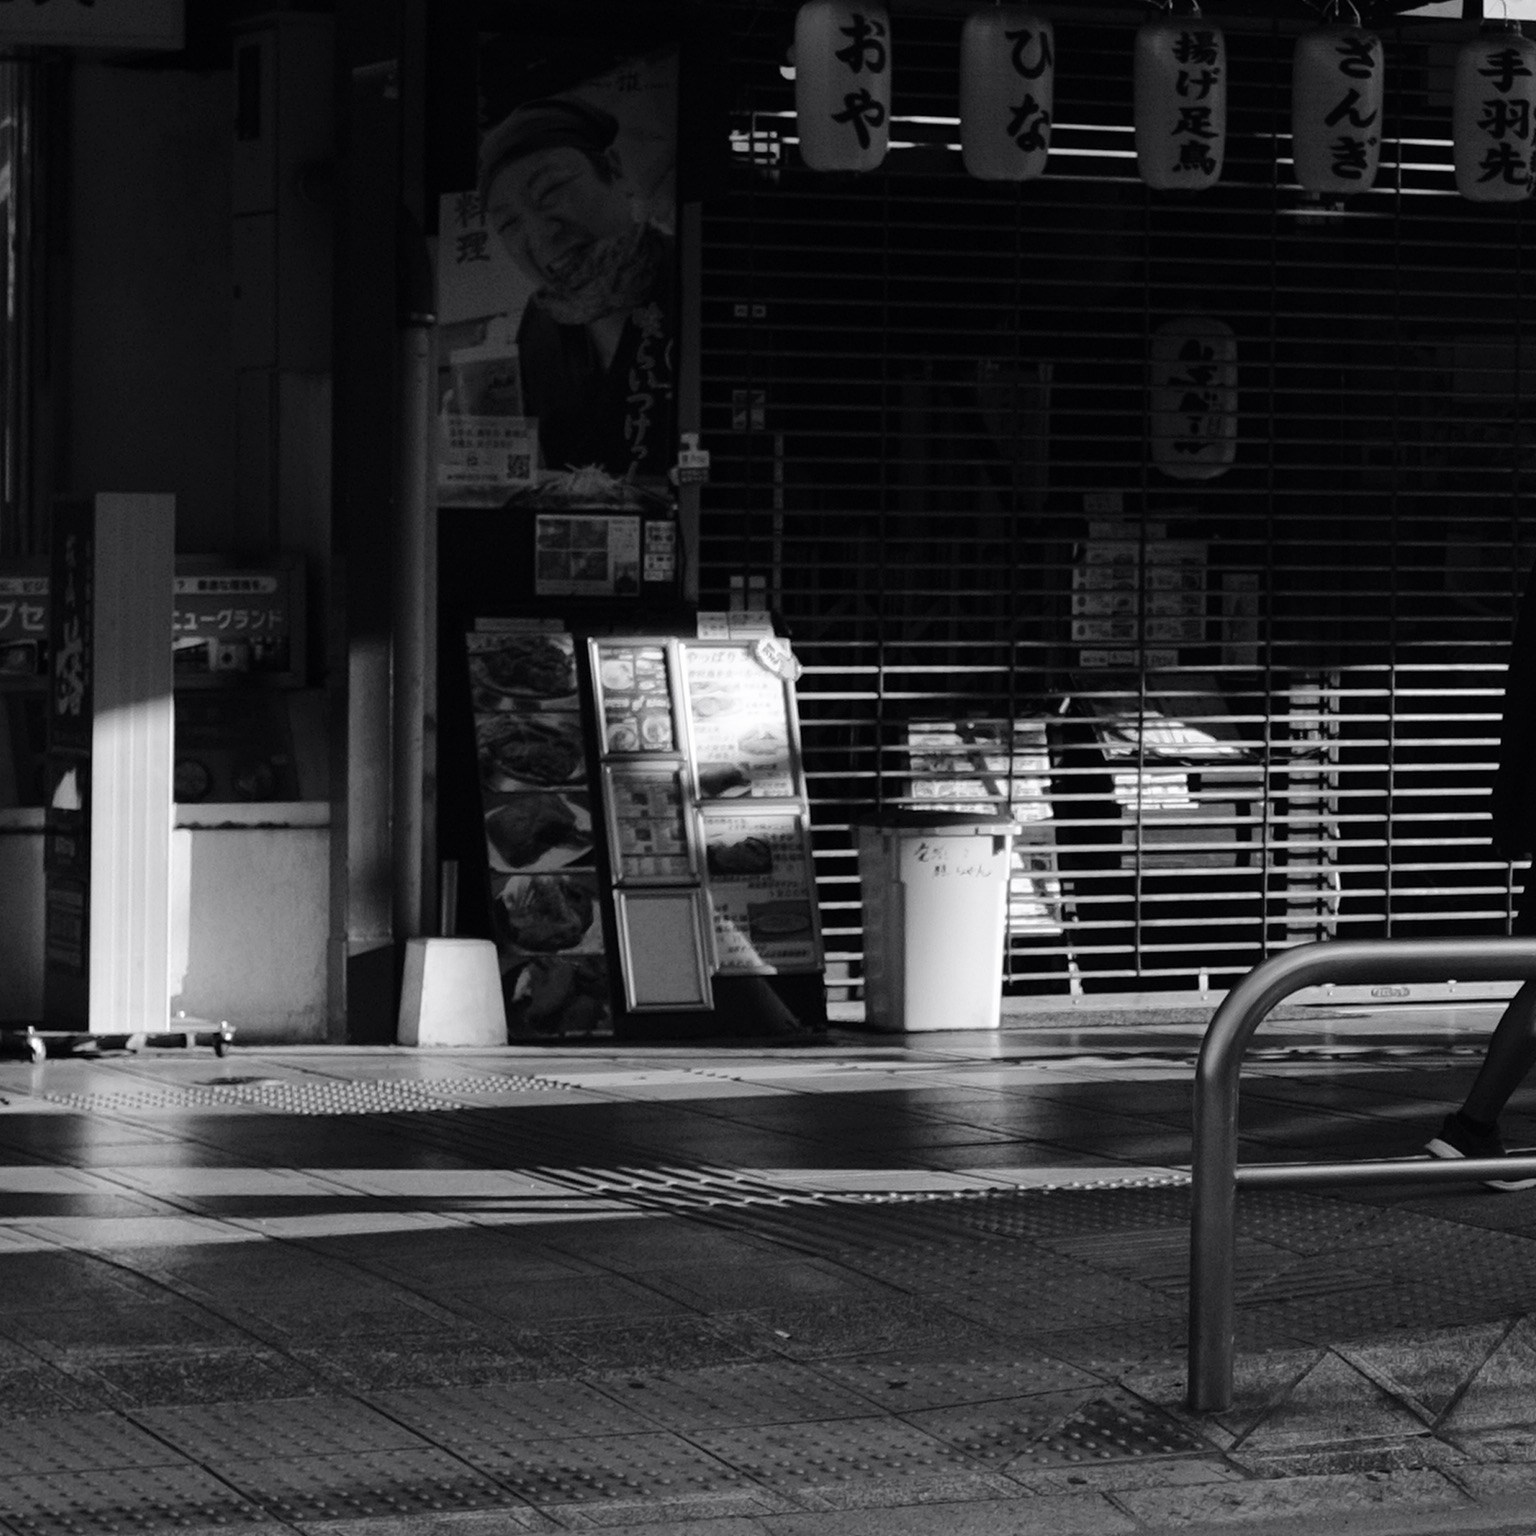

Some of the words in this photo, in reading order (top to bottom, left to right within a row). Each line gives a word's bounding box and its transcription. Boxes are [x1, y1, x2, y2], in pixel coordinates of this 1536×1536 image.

[833, 13, 886, 151] おや
[1005, 28, 1053, 153] ひな
[1476, 48, 1532, 185] 手羽先
